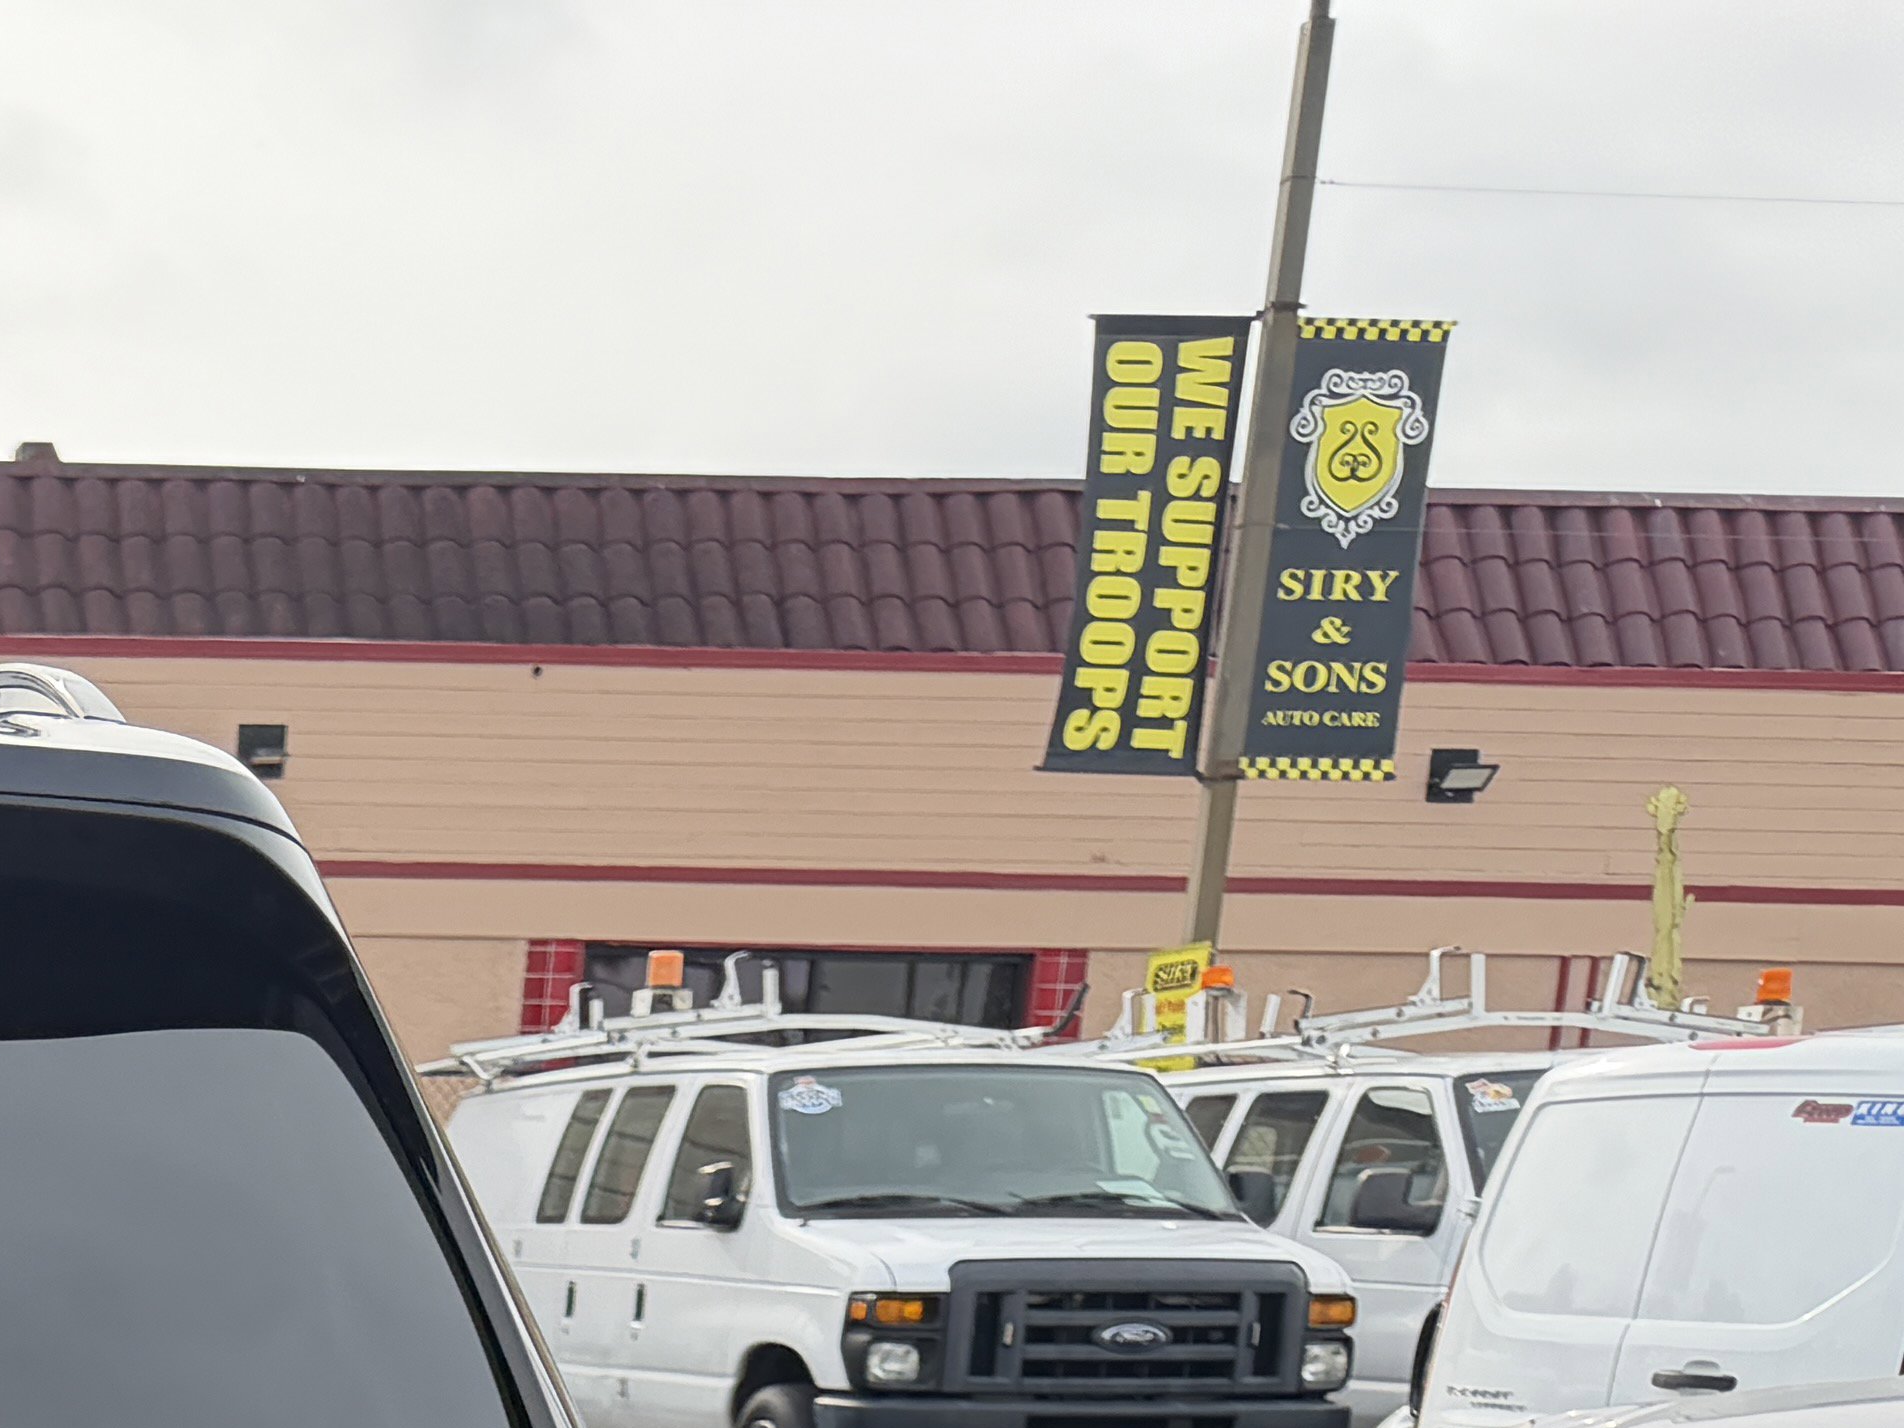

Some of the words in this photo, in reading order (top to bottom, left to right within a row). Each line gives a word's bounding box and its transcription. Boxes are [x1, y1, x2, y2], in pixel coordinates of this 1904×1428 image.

[1100, 341, 1163, 475] OUR
[1172, 336, 1234, 441] WE
[1131, 456, 1221, 759] SUPPORT
[1277, 568, 1400, 602] SIRY
[1063, 490, 1151, 752] TROOPS
[1312, 616, 1352, 645] &
[1264, 660, 1388, 694] SONS
[1261, 710, 1320, 727] AUTO
[1323, 711, 1380, 728] CARE
